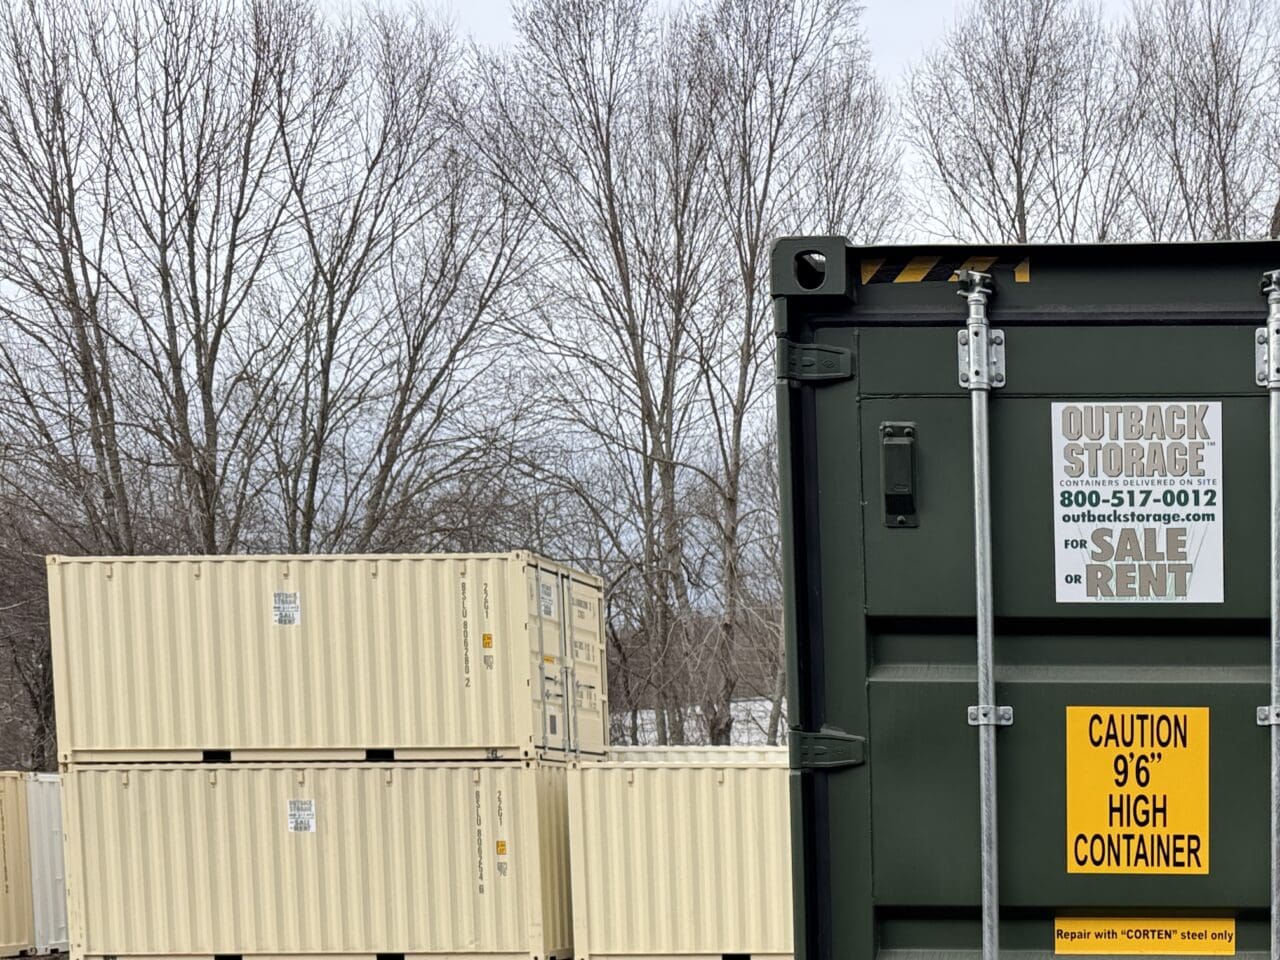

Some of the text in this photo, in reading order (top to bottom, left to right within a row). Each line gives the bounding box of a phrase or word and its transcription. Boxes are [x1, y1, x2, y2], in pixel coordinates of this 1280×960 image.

[1062, 405, 1210, 440] OUTBACK
[1064, 442, 1205, 478] STORAGE
[1059, 479, 1120, 487] CONTAINERS
[1197, 478, 1217, 486] SITE
[1060, 489, 1216, 507] 800-517-0012
[1062, 510, 1215, 524] outbackstorage.com
[1064, 527, 1187, 562] FOR SALE
[1065, 563, 1193, 597] OR RENT
[1089, 713, 1187, 748] CAUTION
[1108, 794, 1167, 828] HIGH
[1074, 833, 1202, 868] CONTAINER
[1056, 929, 1090, 941] Repair
[1094, 929, 1118, 940] with
[1180, 929, 1207, 940] steel
[1210, 930, 1234, 943] only
